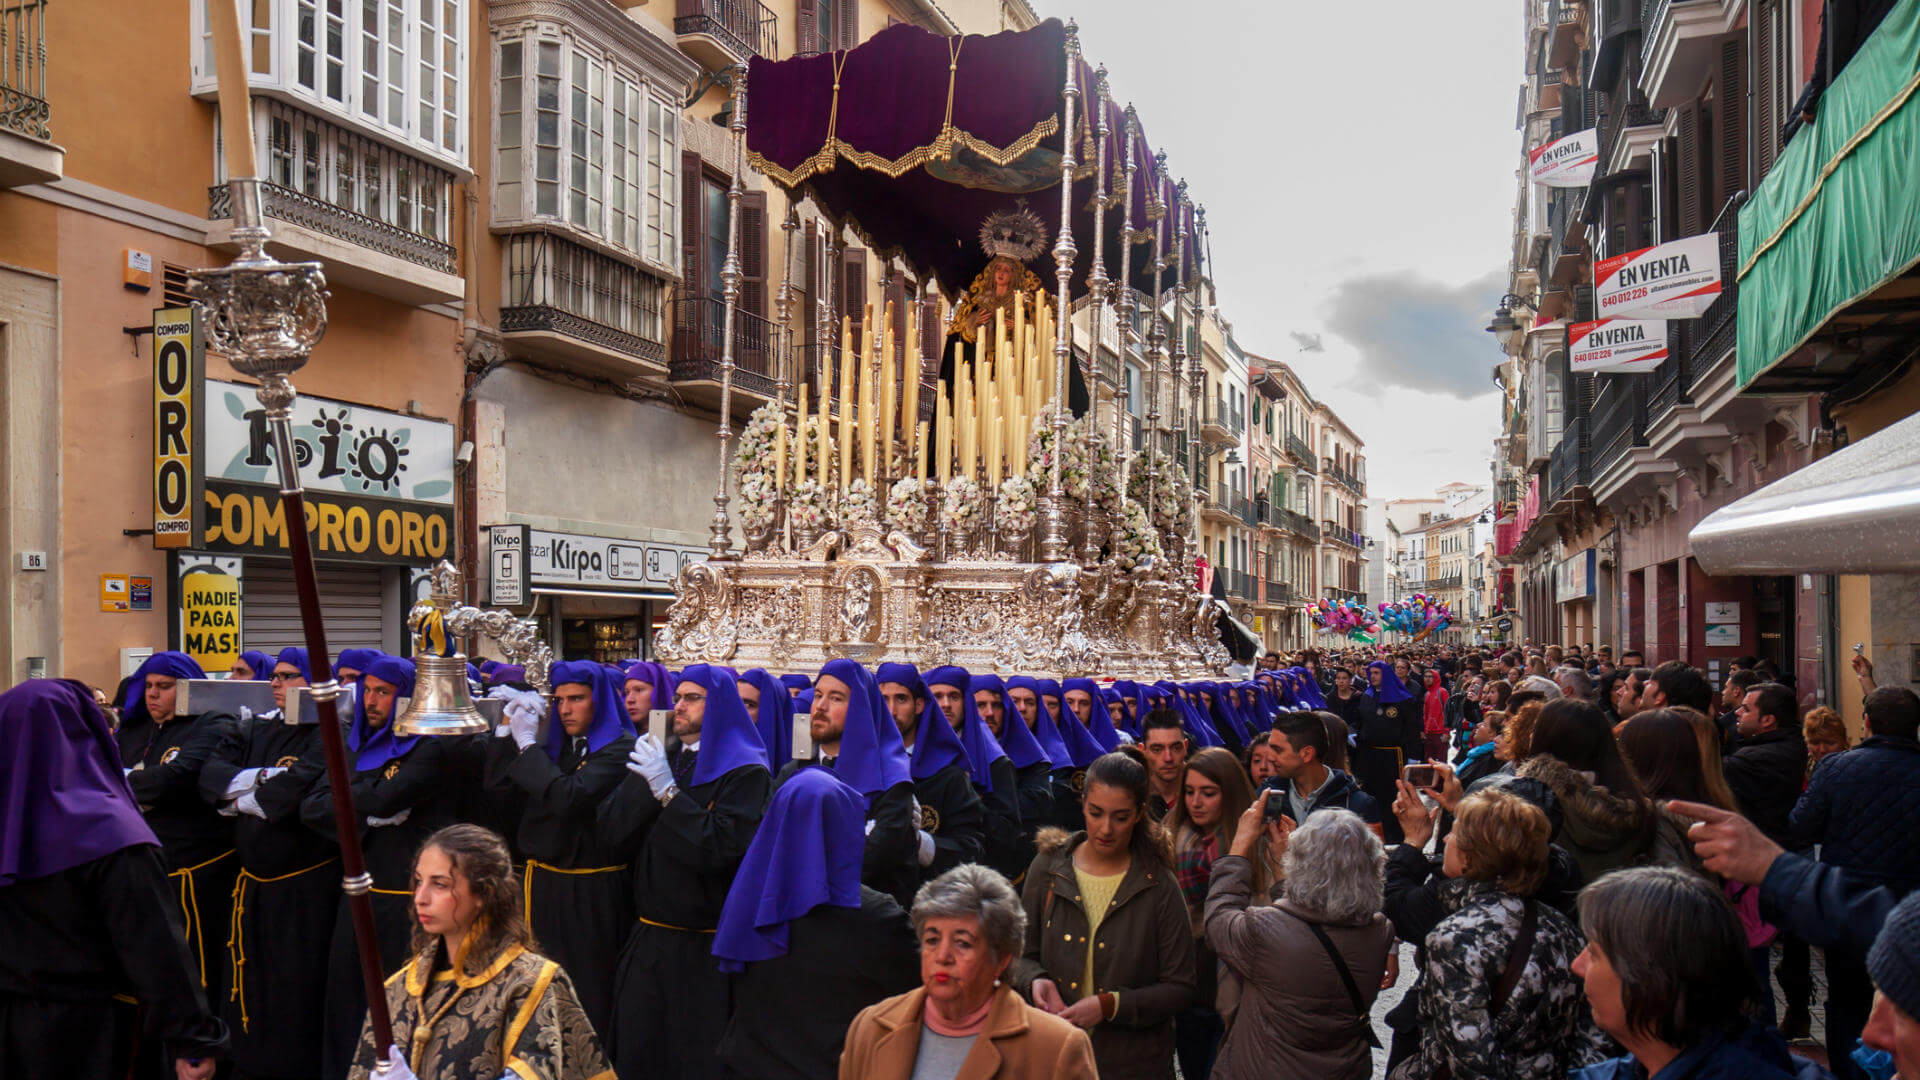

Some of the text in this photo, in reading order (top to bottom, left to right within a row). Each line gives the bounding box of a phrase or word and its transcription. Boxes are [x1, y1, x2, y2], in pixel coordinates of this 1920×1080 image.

[1543, 150, 1553, 164] EN
[1553, 141, 1582, 160] VENTA
[1619, 266, 1637, 288] EN
[1640, 254, 1690, 281] VENTA
[1602, 295, 1617, 308] 640
[1618, 291, 1631, 304] 012
[1632, 287, 1648, 300] 226
[157, 323, 190, 336] COMPRO
[1589, 332, 1603, 349] EN
[1606, 324, 1645, 345] VENTA
[1574, 353, 1587, 364] 640
[1588, 350, 1599, 361] 012
[1600, 348, 1612, 359] 226
[158, 340, 188, 516] ORO
[157, 521, 190, 533] COMPRO
[376, 509, 447, 559] ORO
[494, 534, 520, 548] Kirpa
[28, 554, 41, 567] 86
[551, 538, 603, 581] Kirpa
[186, 591, 238, 609] ¡NADIE
[190, 610, 235, 627] PAGA
[186, 632, 239, 655] MAS!
